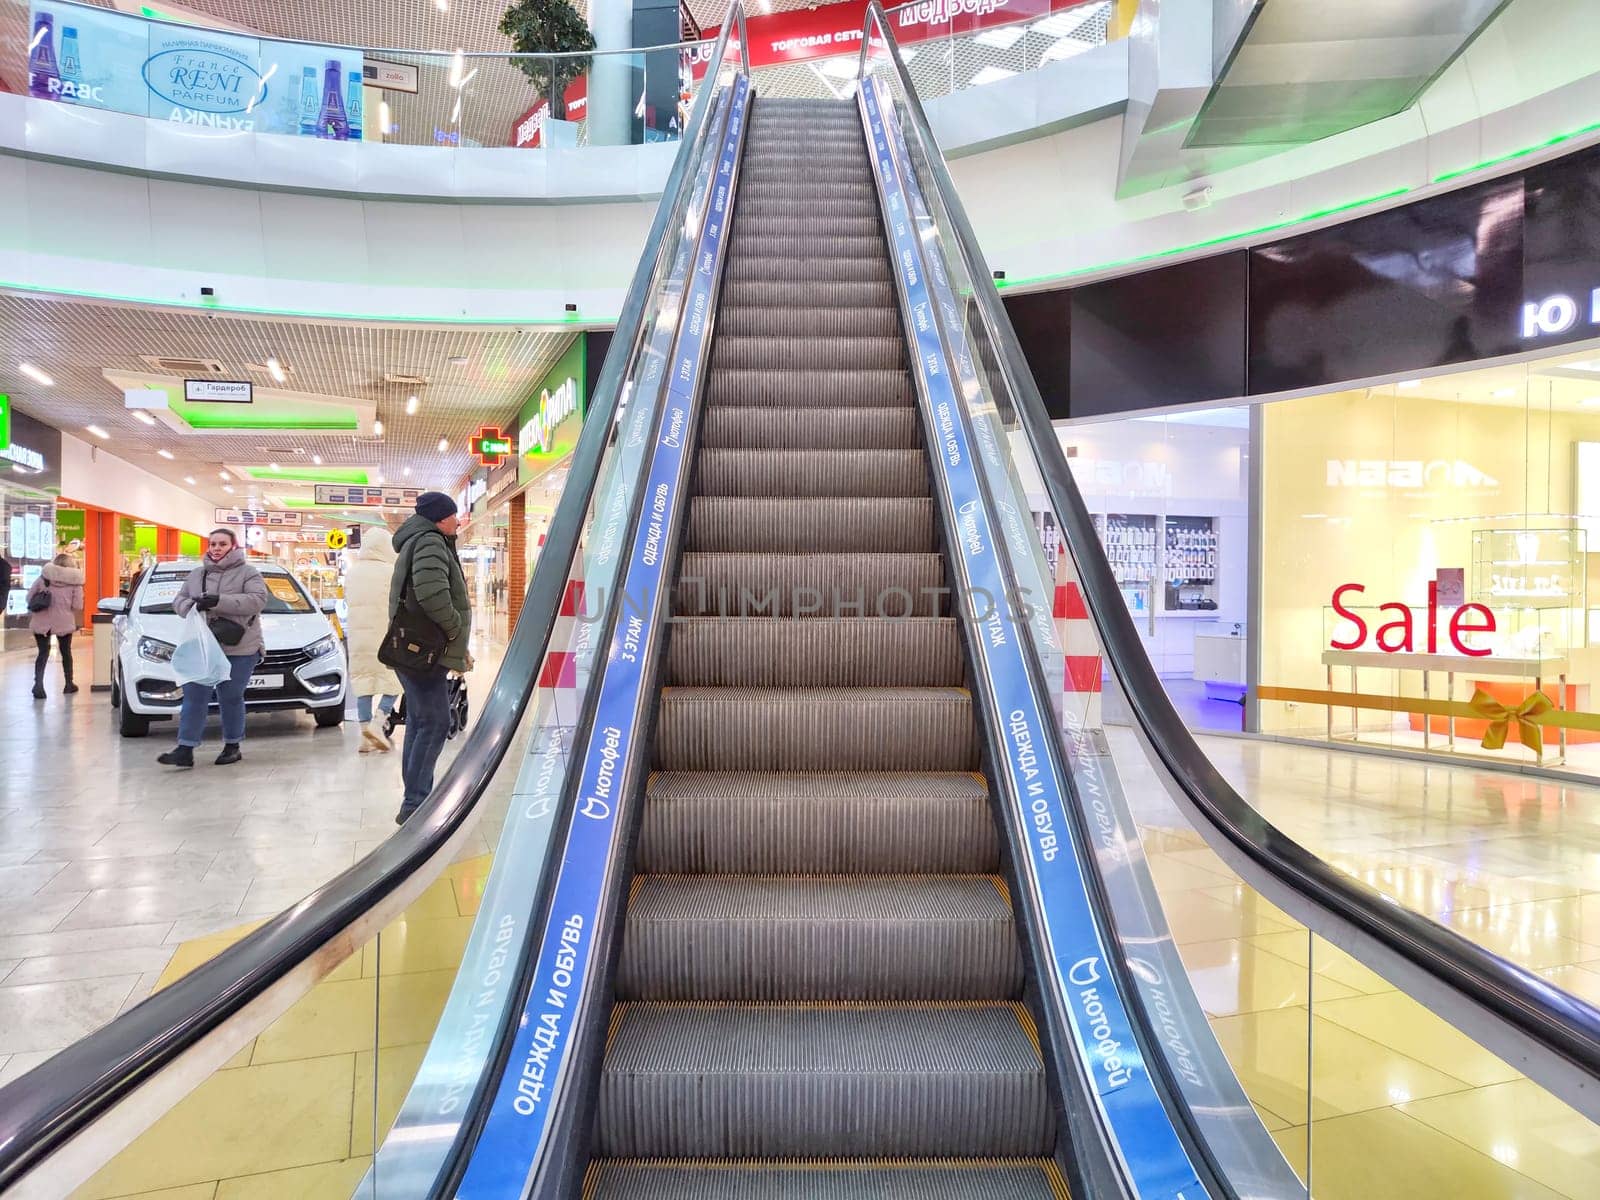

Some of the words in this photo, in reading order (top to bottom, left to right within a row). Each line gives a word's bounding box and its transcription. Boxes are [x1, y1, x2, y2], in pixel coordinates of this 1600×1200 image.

[174, 55, 241, 73] France
[771, 33, 831, 52] ТОРГОВАЯ
[835, 29, 864, 42] СЕТЬ
[170, 67, 246, 93] RENI
[172, 89, 241, 107] PARFUM
[937, 402, 952, 436] ОДЕЖДА
[946, 440, 962, 467] ОБУВЬ
[642, 521, 663, 566] ОДЕЖДА
[657, 482, 670, 513] ОБУВЬ
[624, 615, 645, 654] ЭТАЖ
[987, 610, 1006, 648] ЭТАЖ
[1330, 580, 1497, 657] Sale
[622, 652, 637, 663] 3
[596, 727, 622, 799] котофей
[1009, 709, 1039, 782] ОДЕЖДА
[1025, 781, 1041, 797] И
[1032, 796, 1061, 862] ОБУВЬ
[553, 913, 585, 988] ОБУВЬ
[549, 990, 568, 1009] И
[1080, 987, 1133, 1088] котофей
[513, 1012, 562, 1116] ОДЕЖДА
